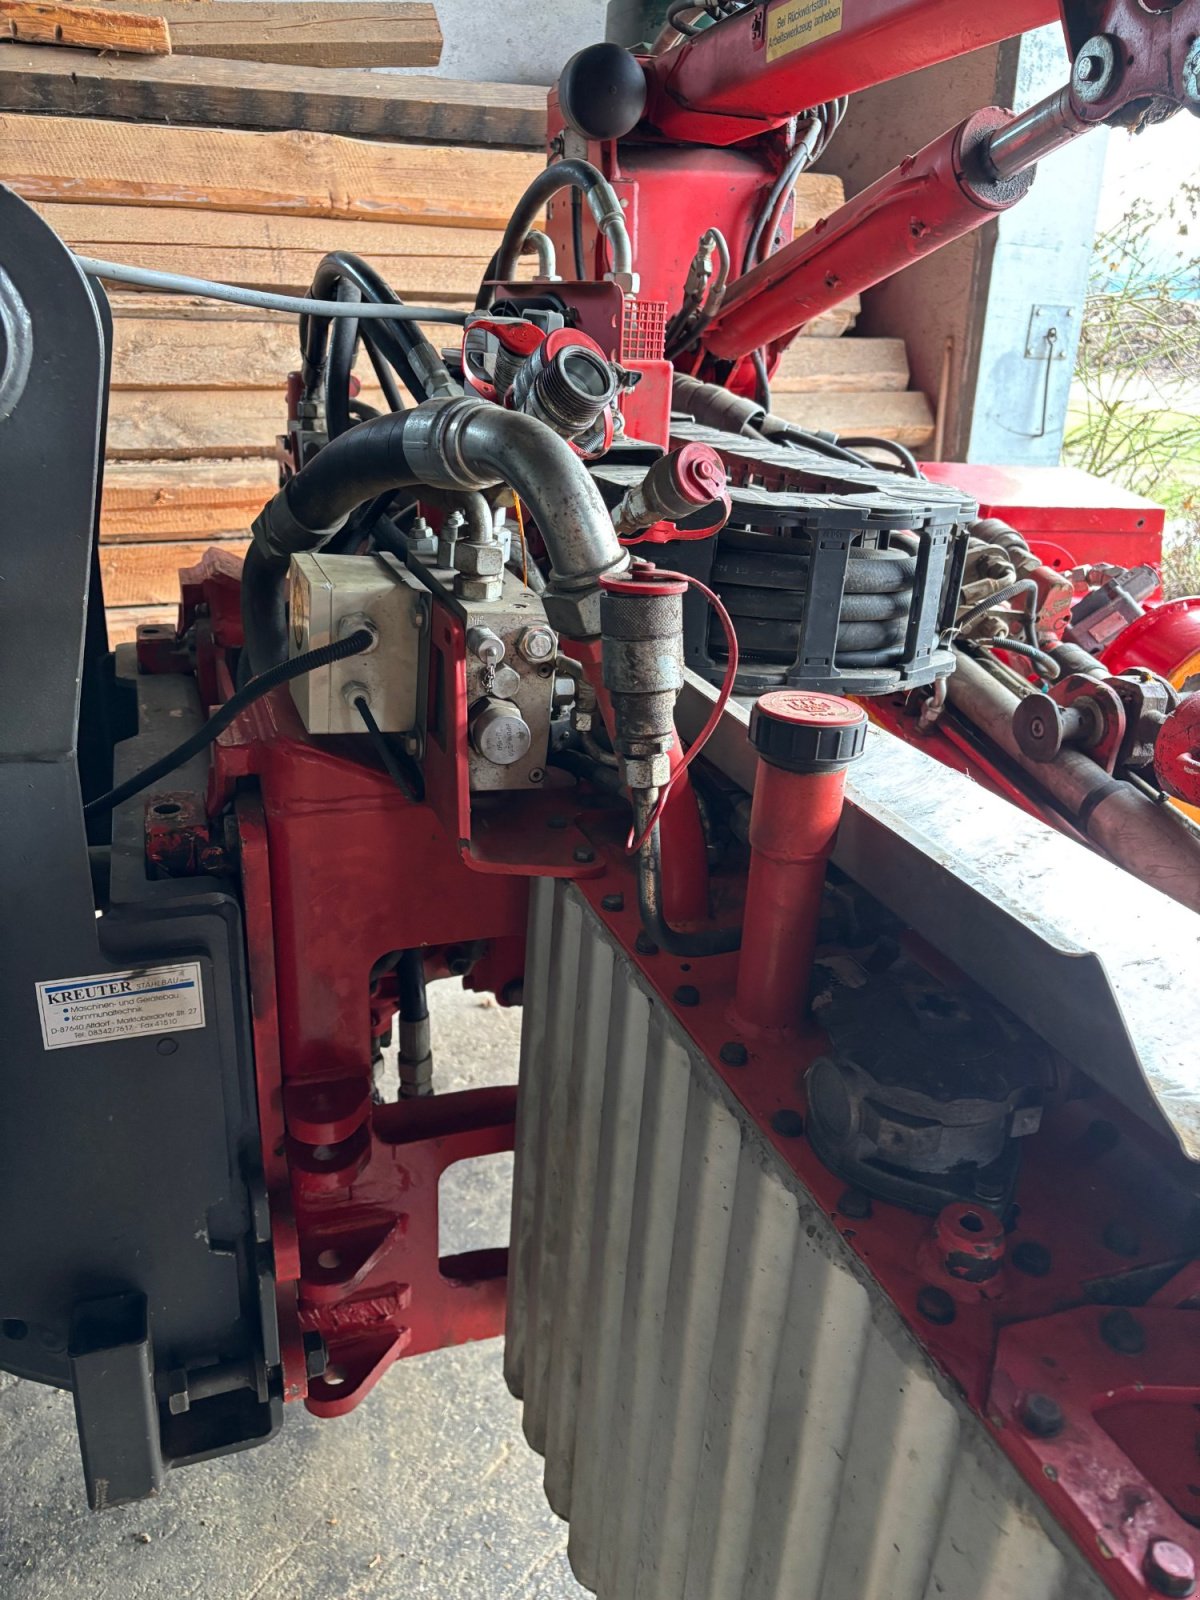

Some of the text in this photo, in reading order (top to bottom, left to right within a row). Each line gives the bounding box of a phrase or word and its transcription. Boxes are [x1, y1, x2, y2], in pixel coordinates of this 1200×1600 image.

[768, 7, 841, 48] Arbeitswerkzeug anheben
[777, 15, 786, 29] Bei
[47, 977, 179, 1005] KREUTER STAHLBAU
[71, 1002, 117, 1013] Maschinen-
[118, 998, 135, 1007] und
[71, 1006, 143, 1022] Kommunaltechnik
[86, 1021, 110, 1029] Altdorf
[116, 1011, 175, 1025] Marktoberdorfer
